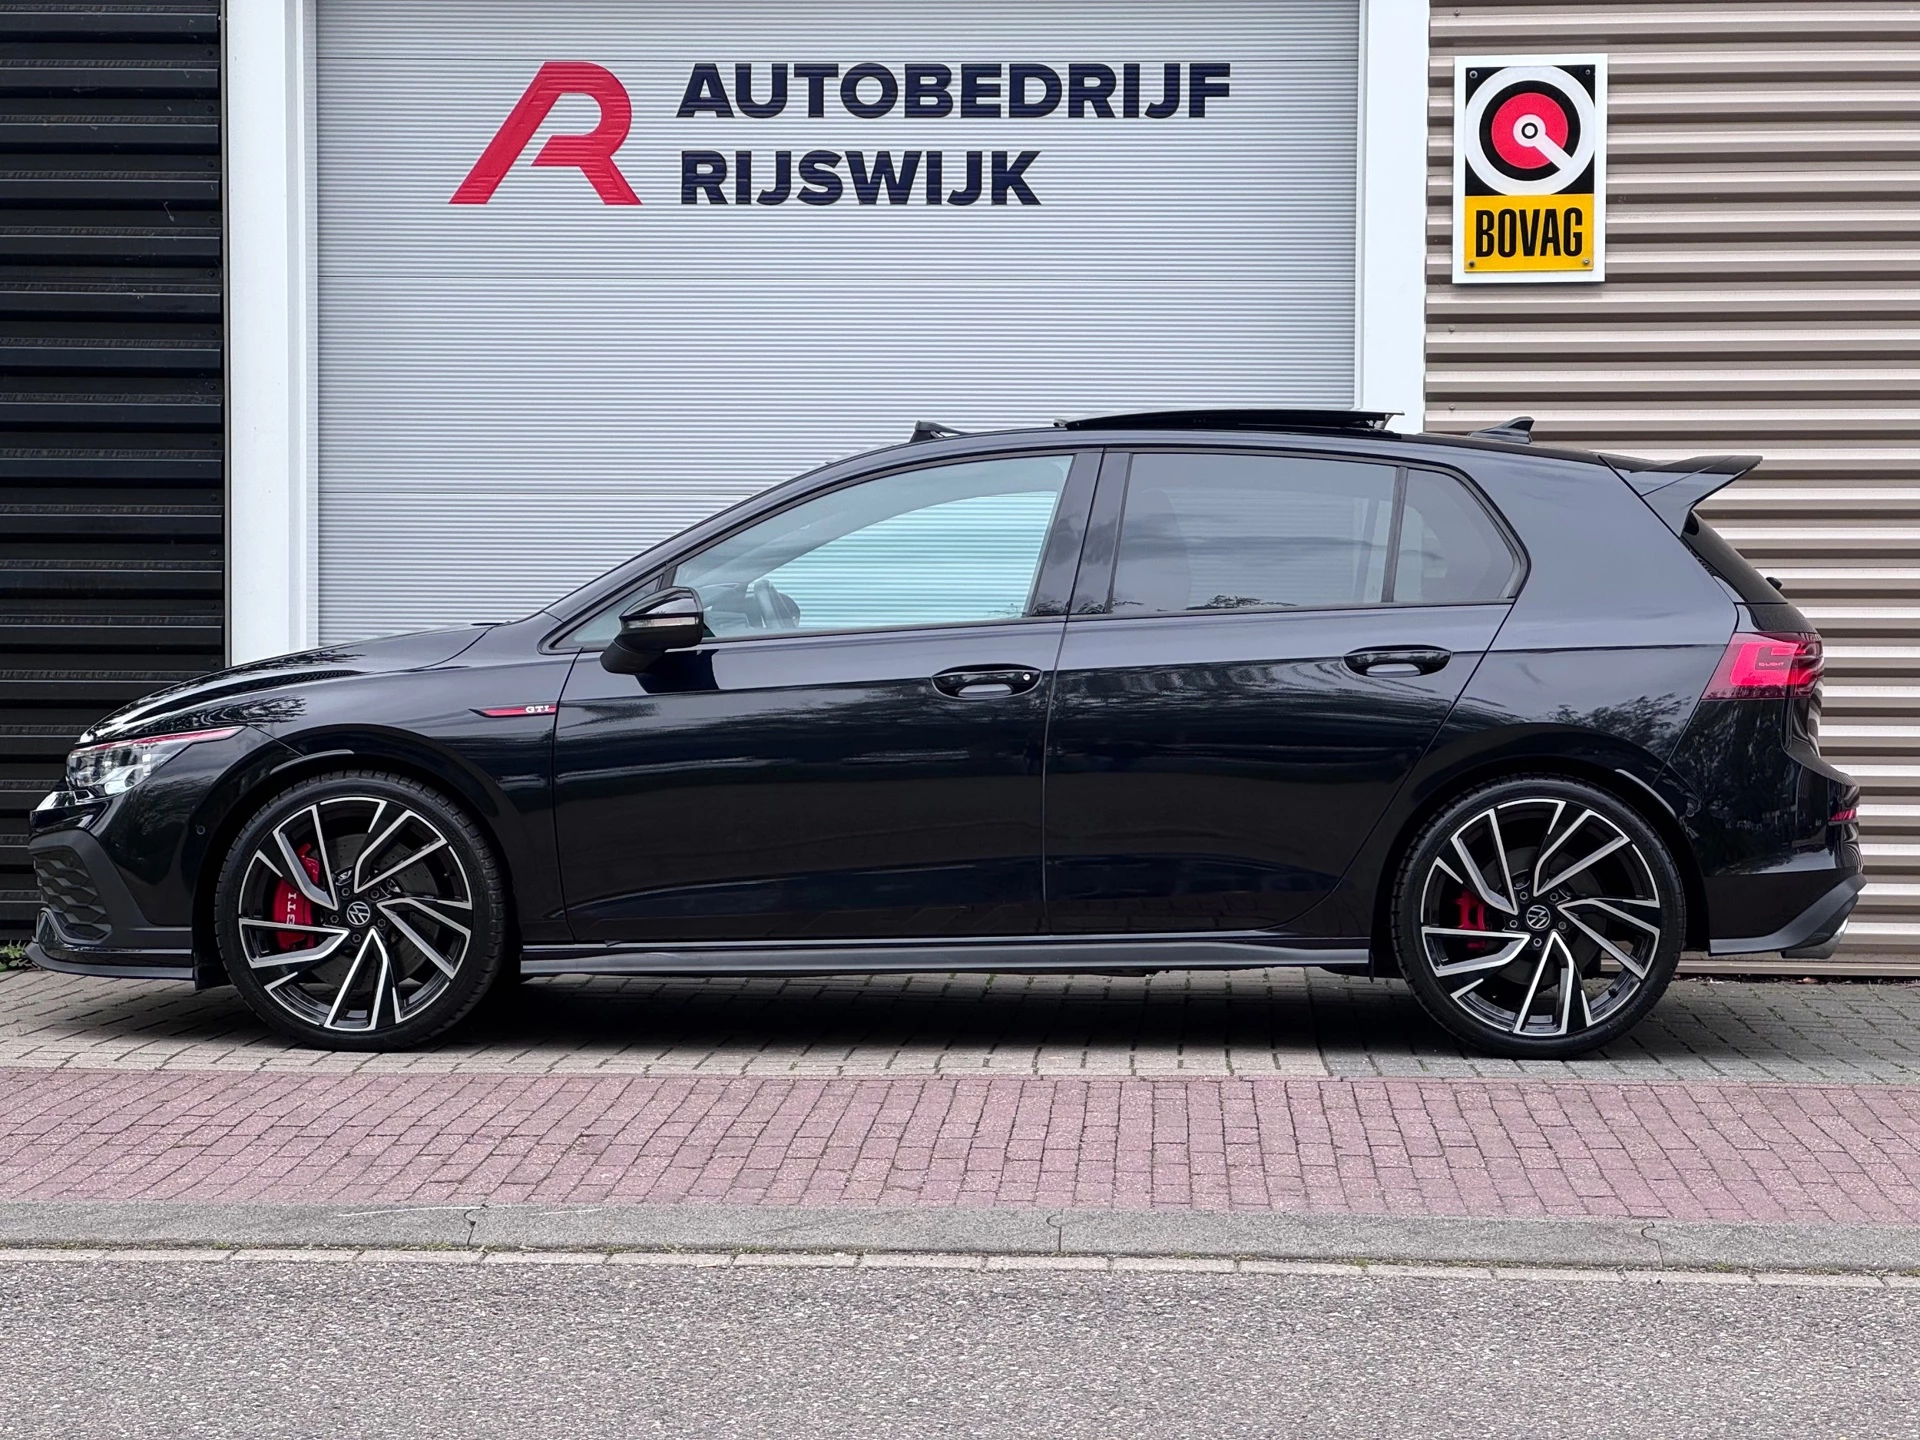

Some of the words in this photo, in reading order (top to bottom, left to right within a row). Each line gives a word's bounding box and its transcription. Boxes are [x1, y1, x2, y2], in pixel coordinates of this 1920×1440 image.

[675, 62, 1232, 120] AUTOBEDRIJF
[680, 149, 1042, 206] RIJSWIJK
[1475, 207, 1583, 258] BOVAG
[525, 705, 550, 714] GTI
[286, 892, 297, 925] GTI
